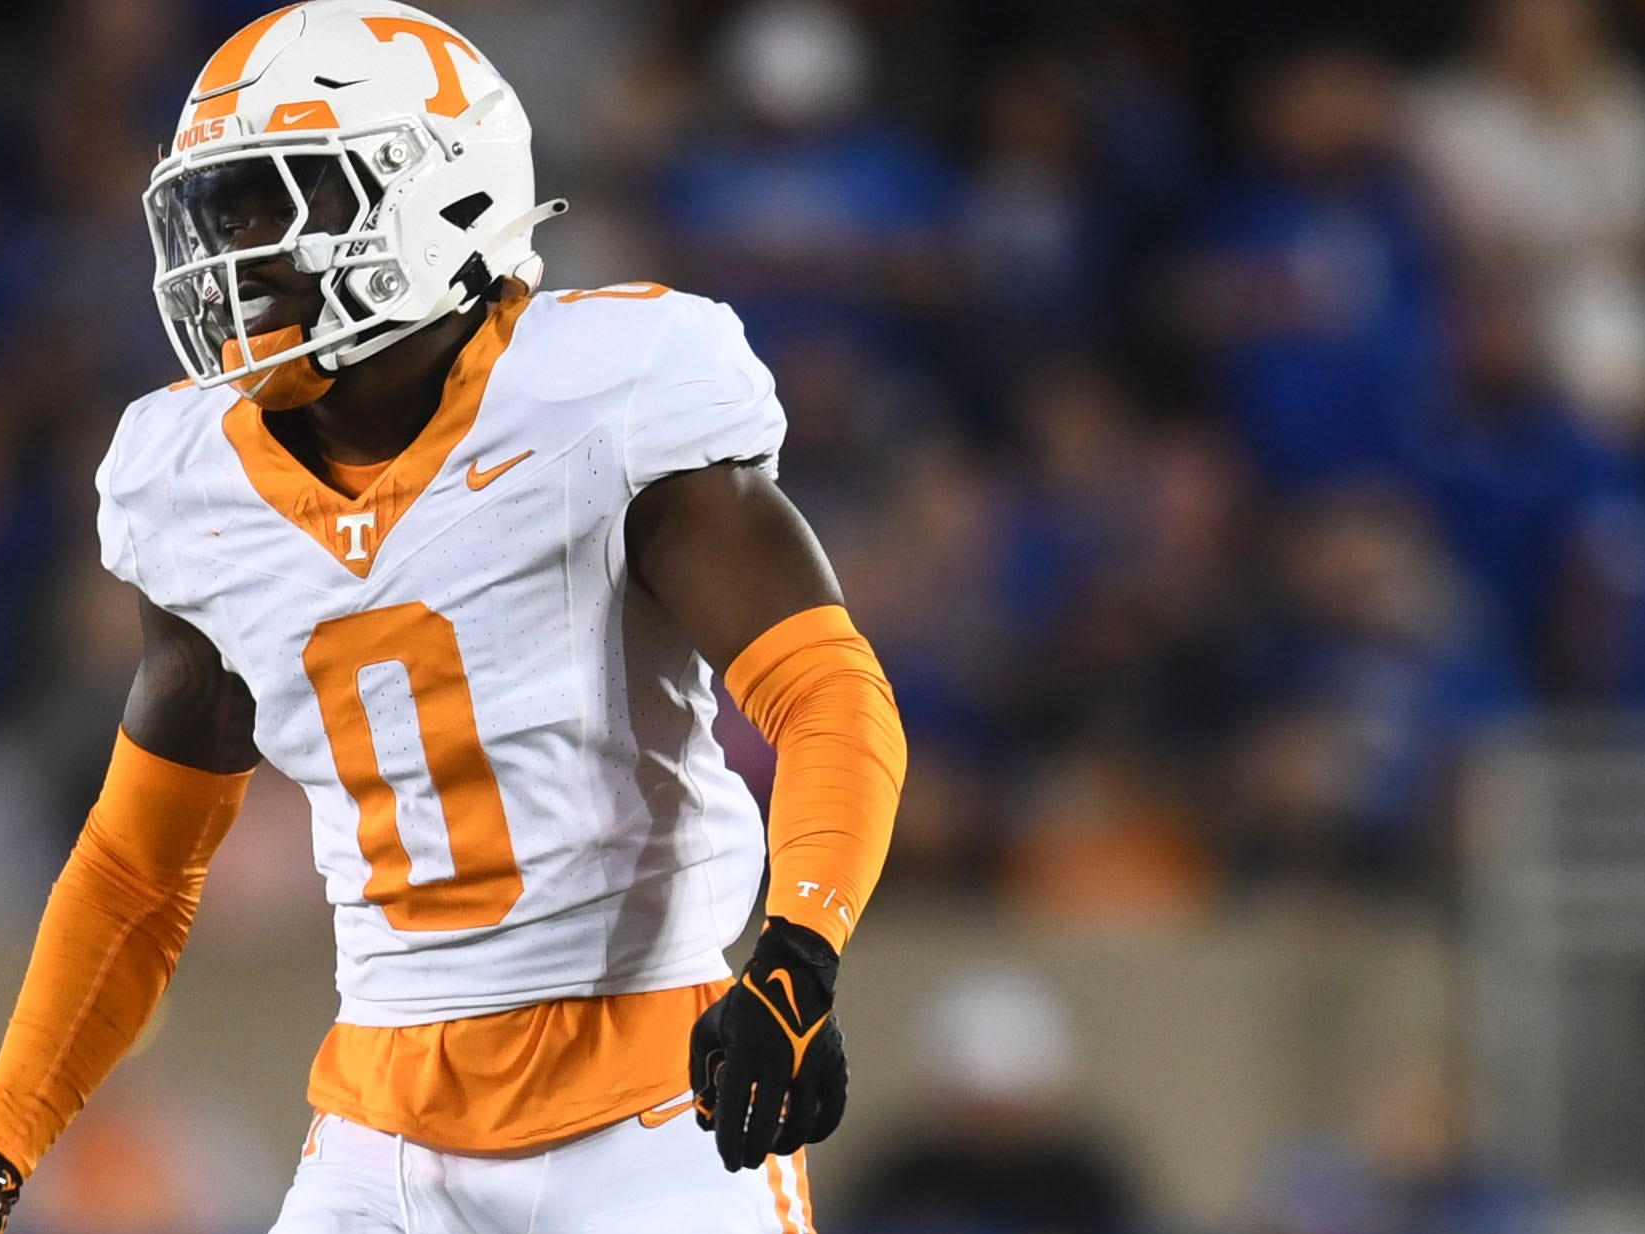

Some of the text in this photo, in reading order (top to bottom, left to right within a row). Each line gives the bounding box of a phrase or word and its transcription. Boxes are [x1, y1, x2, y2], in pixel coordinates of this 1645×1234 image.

[360, 16, 481, 119] T
[176, 118, 227, 151] VOLS
[336, 512, 375, 561] T
[301, 600, 525, 931] 0
[796, 880, 820, 898] T
